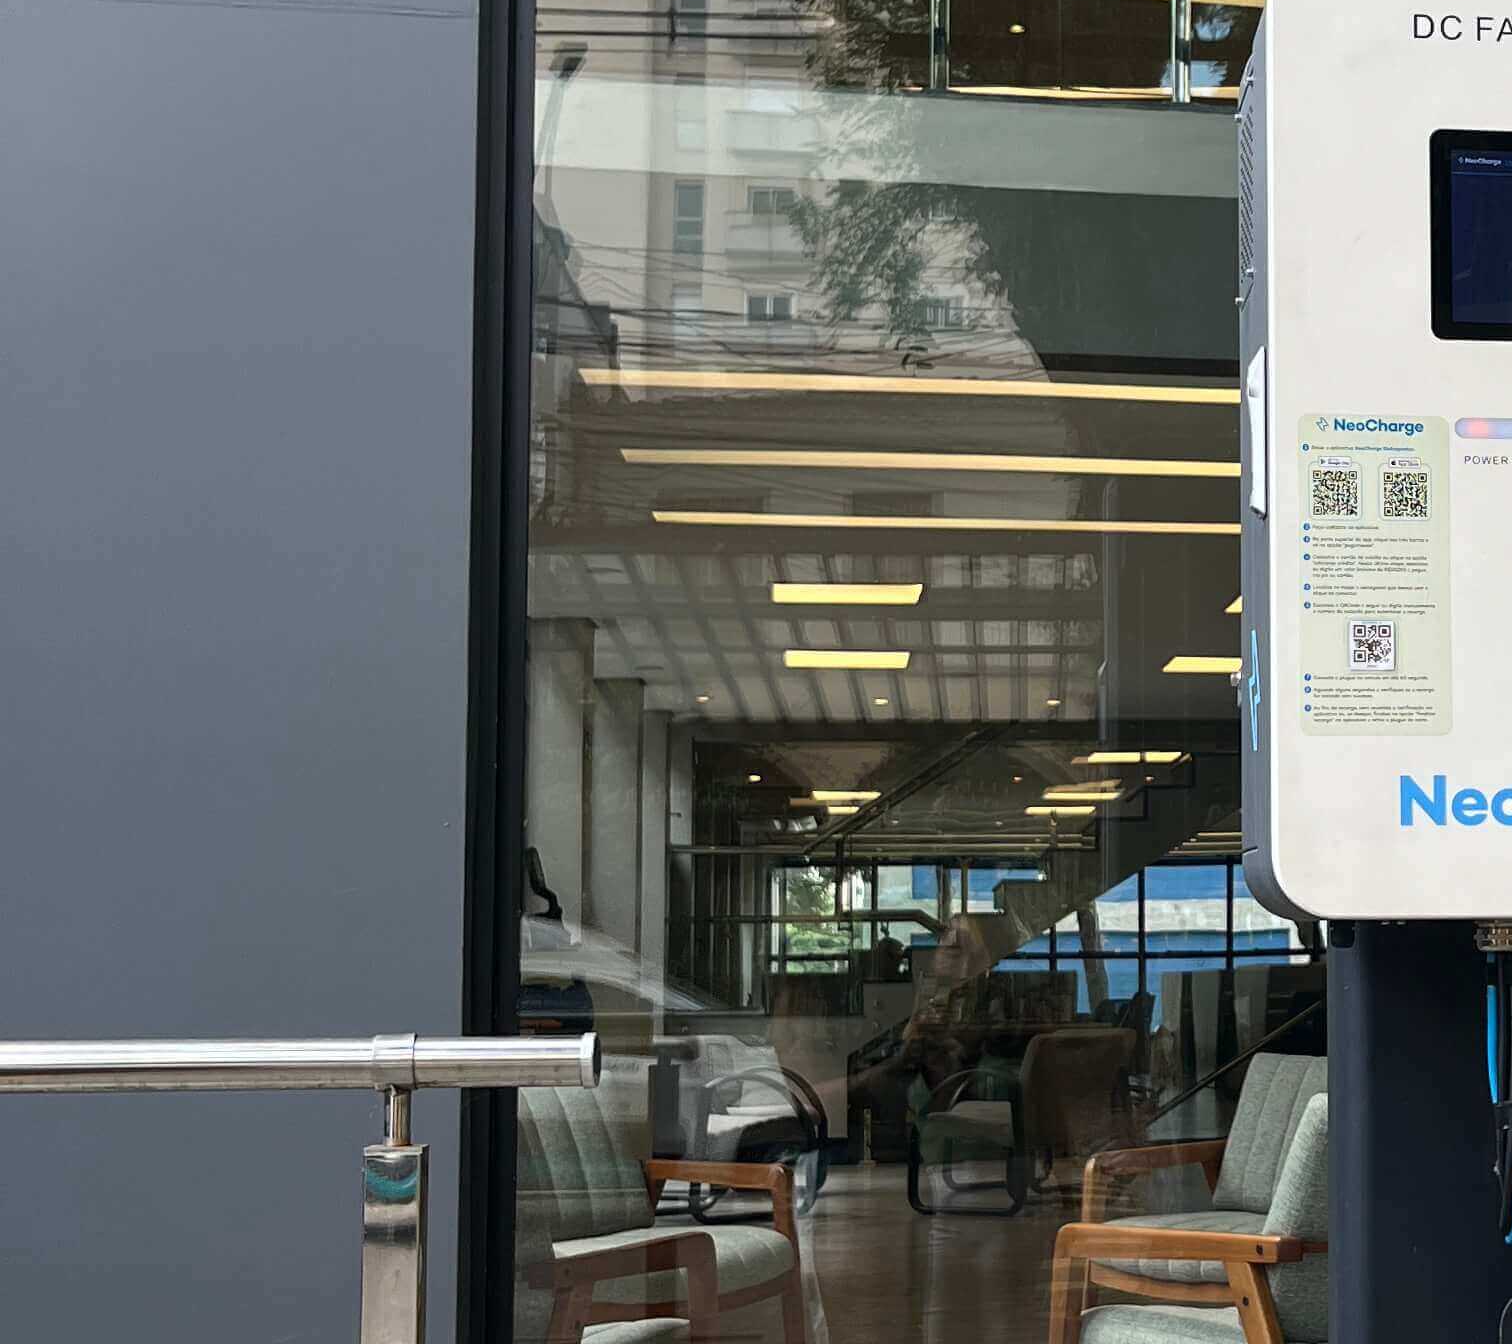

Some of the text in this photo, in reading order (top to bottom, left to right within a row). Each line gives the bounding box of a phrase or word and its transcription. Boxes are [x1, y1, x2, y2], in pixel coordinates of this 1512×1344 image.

[1412, 13, 1463, 40] DC
[1334, 418, 1424, 436] NeoCharge
[1464, 455, 1509, 465] POWER
